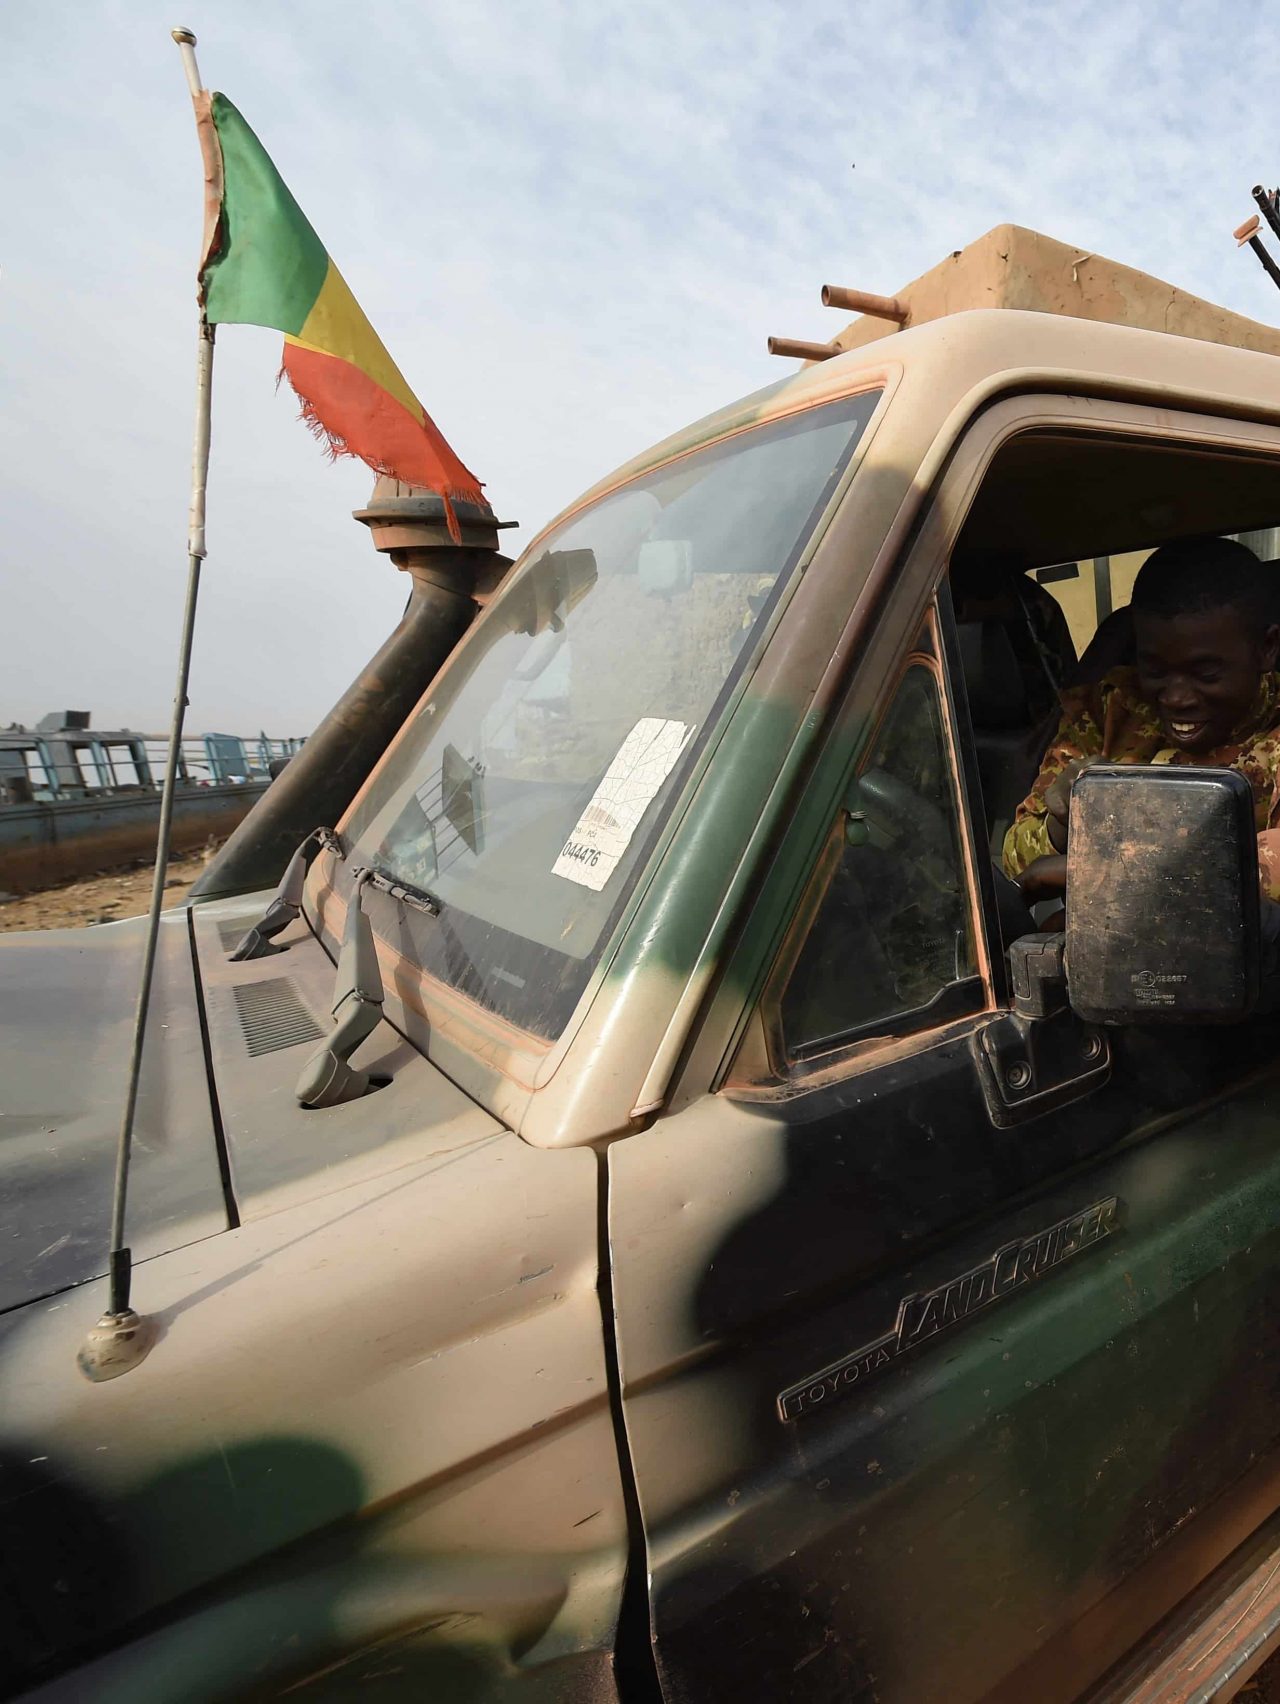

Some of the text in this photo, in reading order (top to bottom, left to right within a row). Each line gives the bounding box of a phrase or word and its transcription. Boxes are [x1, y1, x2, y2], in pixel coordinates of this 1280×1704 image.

[562, 841, 602, 867] 044476
[795, 1206, 1116, 1412] TOYOTA LAND CRUISER
